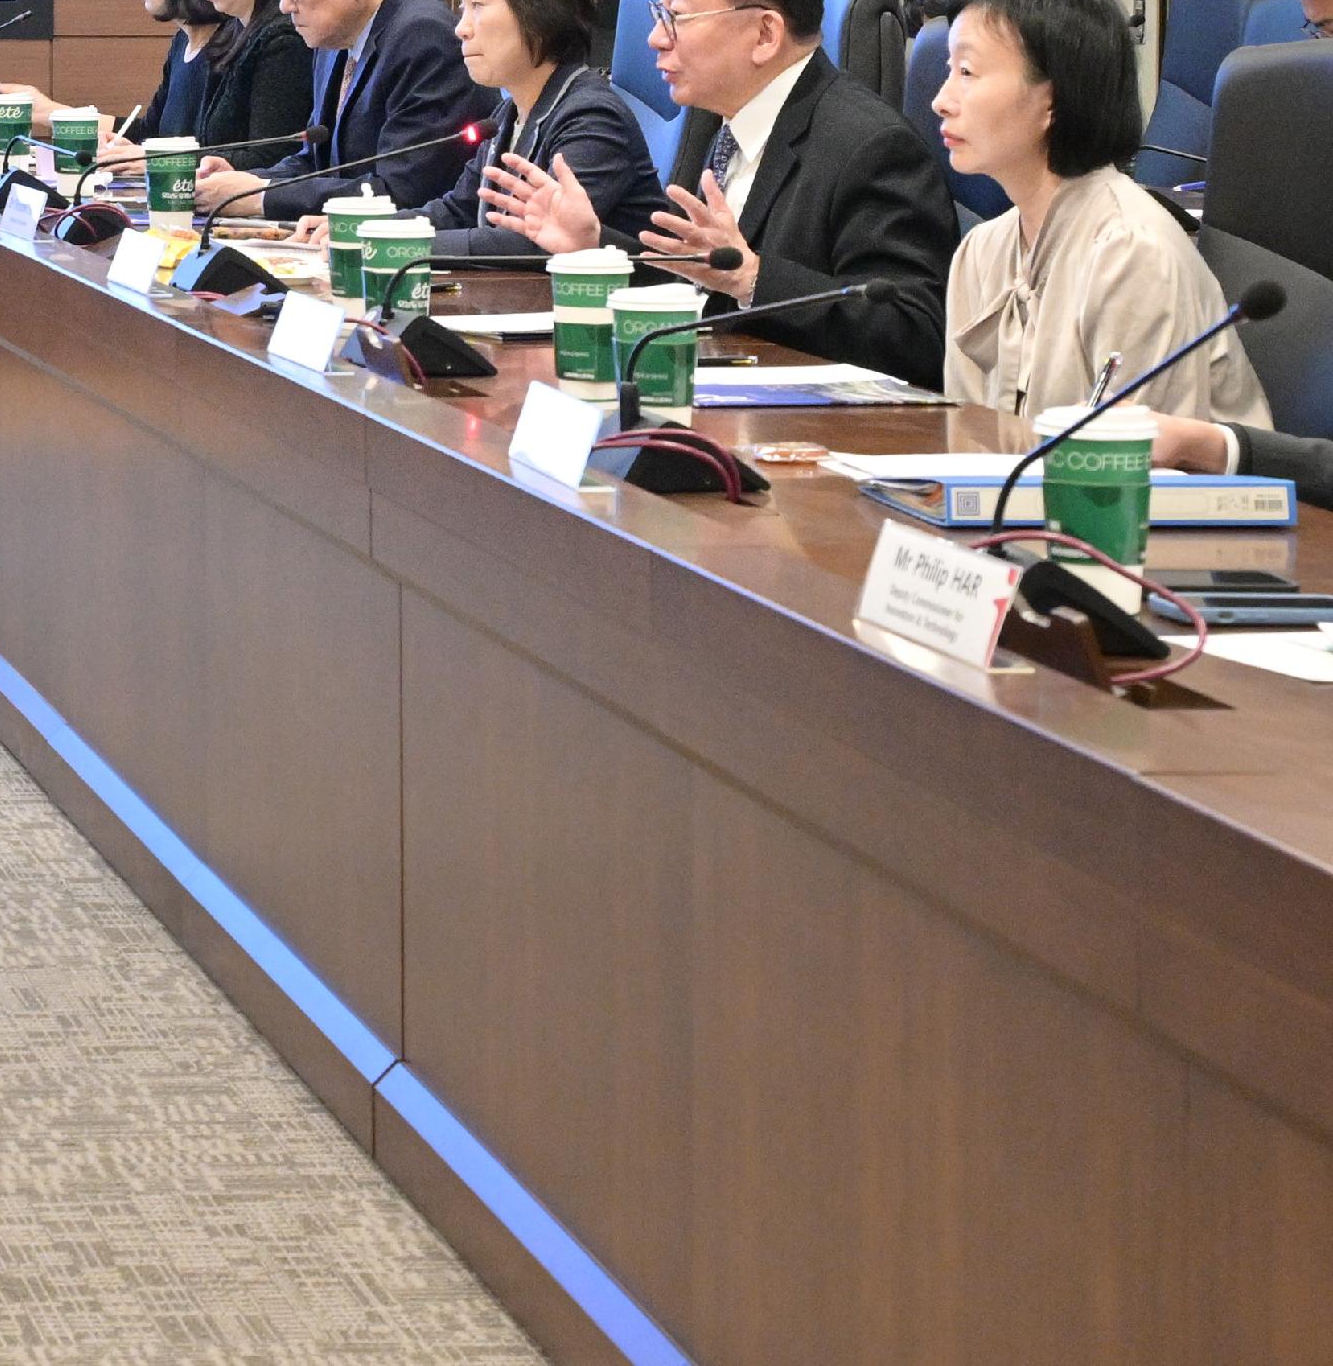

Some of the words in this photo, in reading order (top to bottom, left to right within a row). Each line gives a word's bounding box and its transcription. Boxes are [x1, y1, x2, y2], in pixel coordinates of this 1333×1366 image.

[1067, 451, 1144, 472] COFFEE
[894, 545, 912, 572] Mr
[915, 552, 949, 592] Philip
